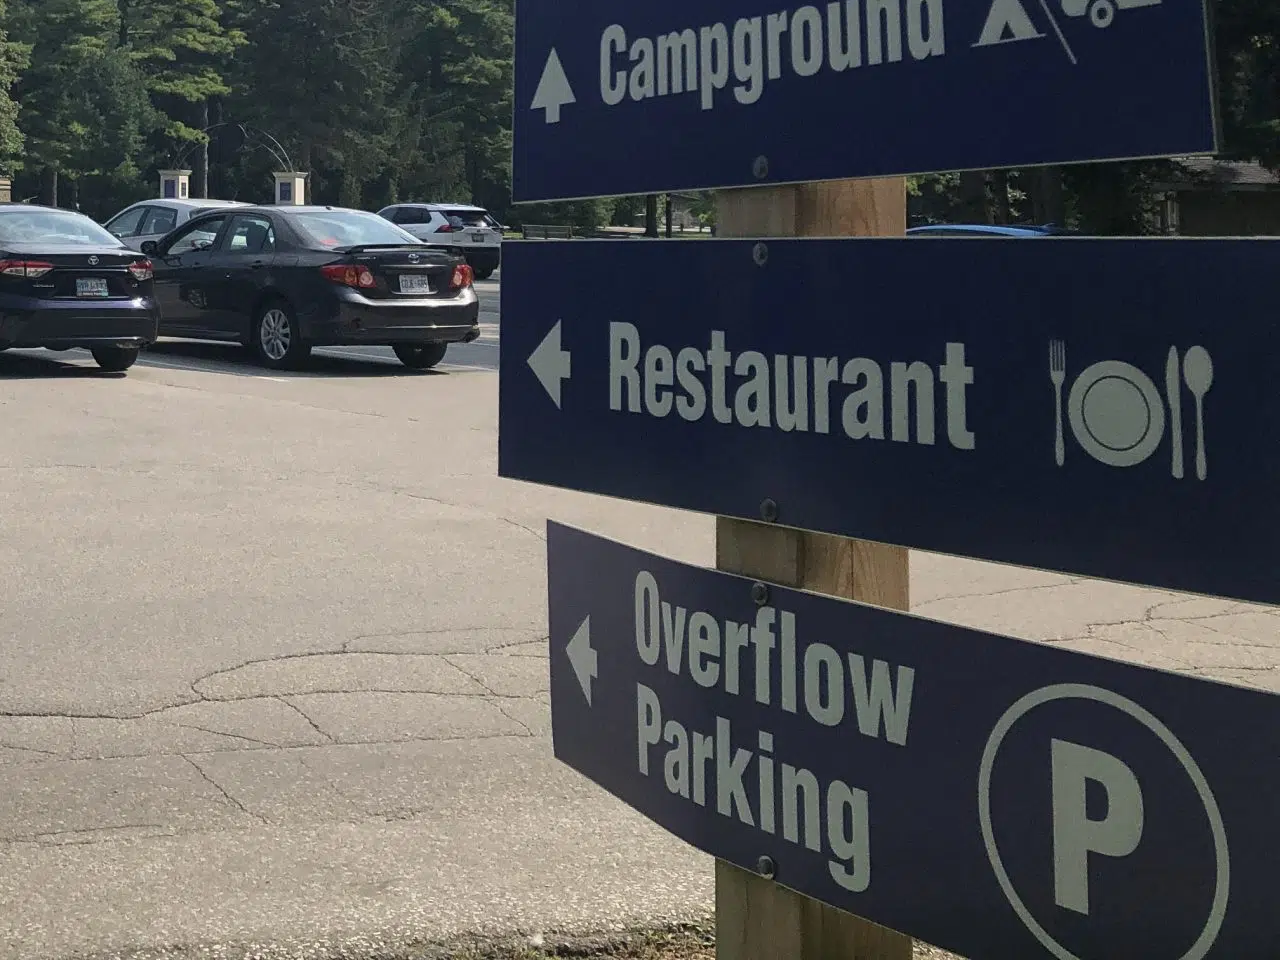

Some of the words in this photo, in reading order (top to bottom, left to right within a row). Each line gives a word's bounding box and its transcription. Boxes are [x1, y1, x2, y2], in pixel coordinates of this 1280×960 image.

[609, 321, 975, 450] Restaurant
[634, 570, 915, 746] Overflow
[636, 682, 871, 893] Parking
[1050, 738, 1144, 915] P
